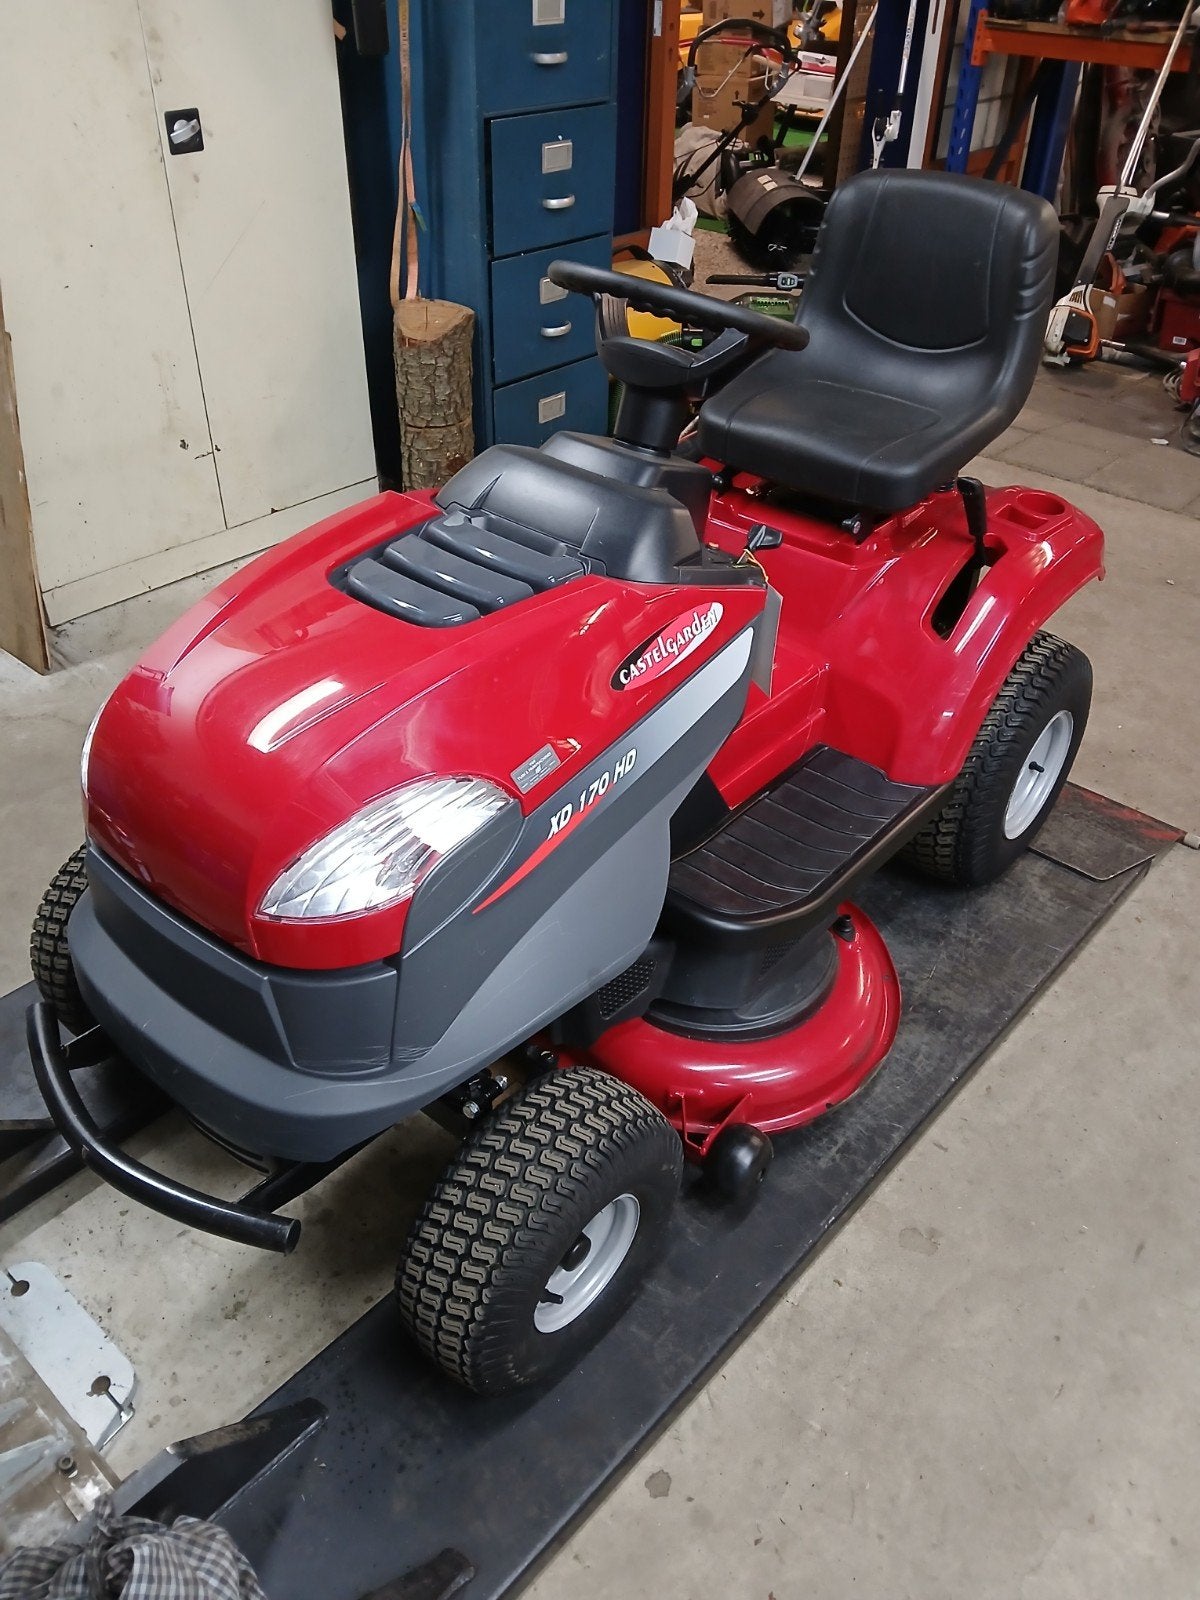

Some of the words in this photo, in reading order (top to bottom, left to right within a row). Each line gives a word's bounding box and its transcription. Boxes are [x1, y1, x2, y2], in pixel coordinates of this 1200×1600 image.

[547, 802, 573, 841] XD
[579, 771, 610, 813] 170
[613, 748, 637, 784] HD
